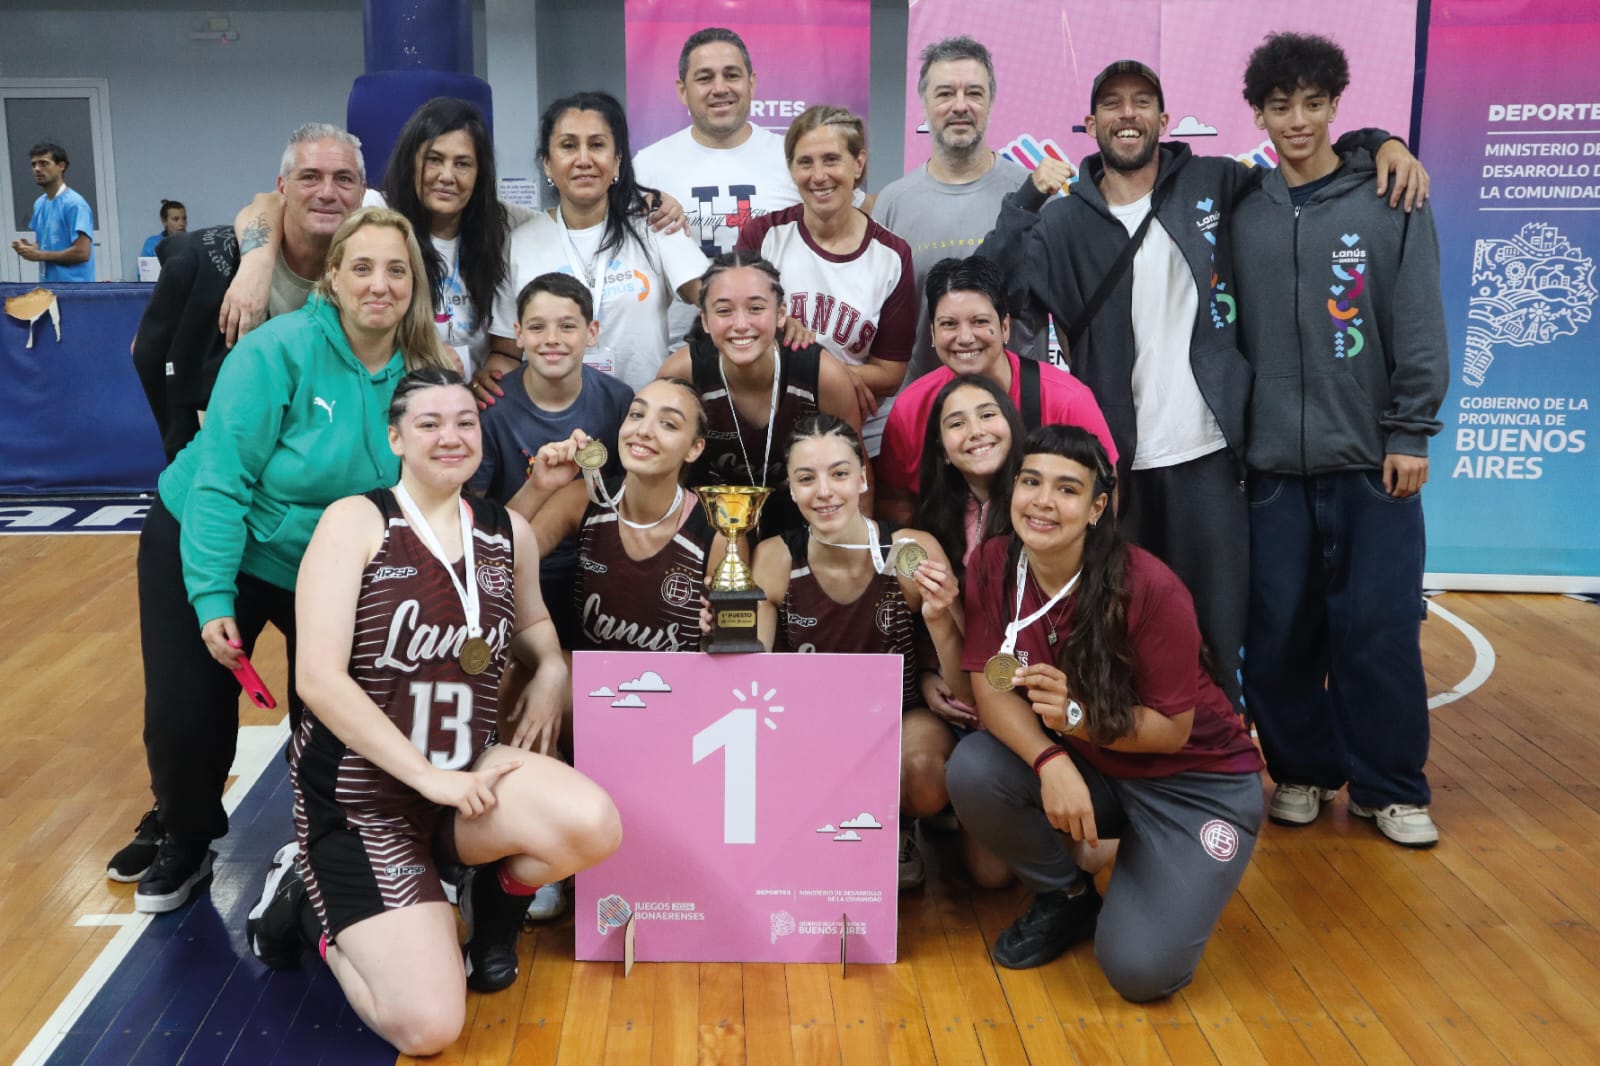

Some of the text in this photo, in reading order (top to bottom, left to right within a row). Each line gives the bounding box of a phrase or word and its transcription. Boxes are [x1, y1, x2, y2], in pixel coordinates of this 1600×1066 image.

[1485, 143, 1579, 156] MINISTERIO
[1482, 165, 1590, 178] DESARROLLO
[1480, 186, 1500, 199] LA
[791, 292, 877, 354] ANUS
[1460, 397, 1589, 410] GOBIERNO DE LA
[1458, 412, 1567, 426] PROVINCIA DE
[1456, 428, 1586, 453] BUENOS
[1452, 456, 1543, 480] AIRES
[409, 681, 473, 770] 13
[693, 708, 756, 844] 1
[635, 902, 670, 911] JUEGOS
[635, 912, 705, 921] BONAERENSES
[799, 926, 837, 935] BUENOS
